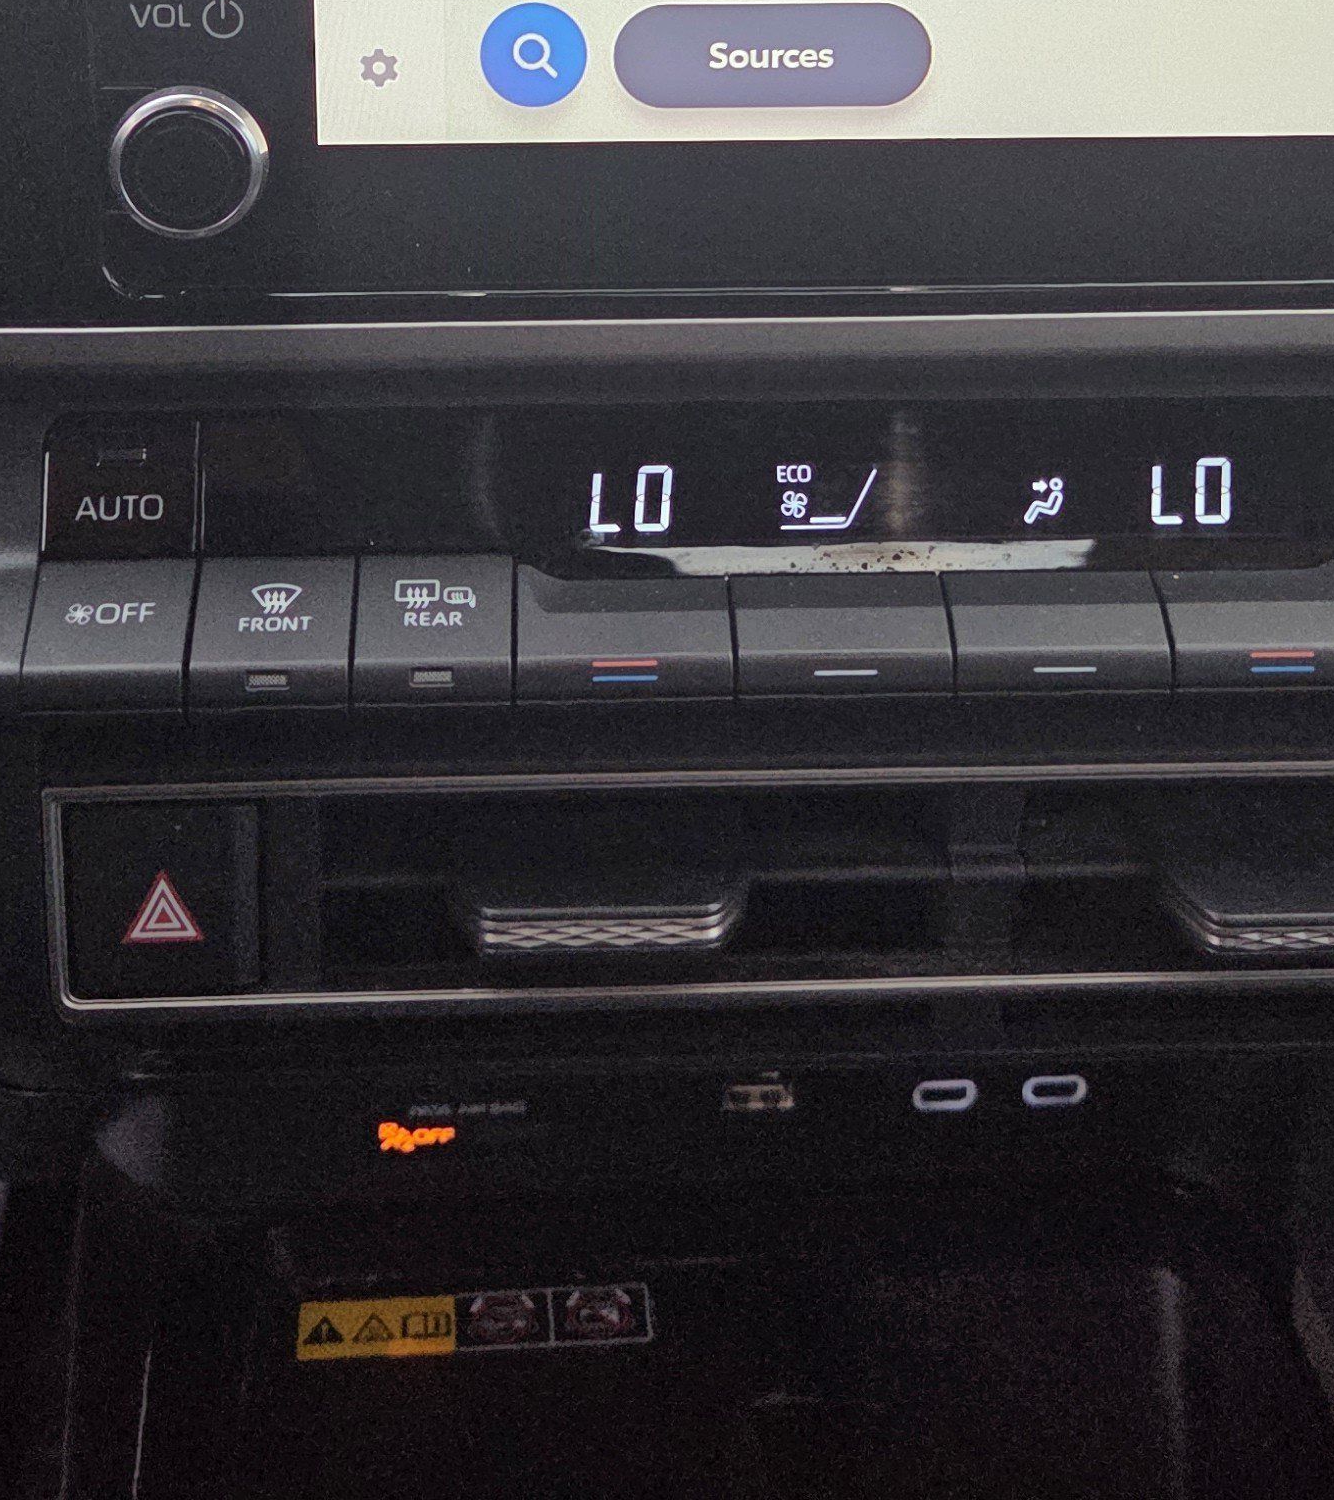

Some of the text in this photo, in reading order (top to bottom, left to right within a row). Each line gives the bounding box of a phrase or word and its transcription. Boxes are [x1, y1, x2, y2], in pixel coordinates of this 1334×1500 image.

[129, 3, 192, 28] VOL
[709, 42, 834, 69] Sources
[776, 464, 812, 483] ECO
[588, 463, 673, 533] LO
[1150, 456, 1232, 526] LO
[75, 494, 164, 521] AUTO
[95, 602, 156, 625] OFF
[238, 615, 312, 632] FRONT
[403, 611, 463, 627] REAR
